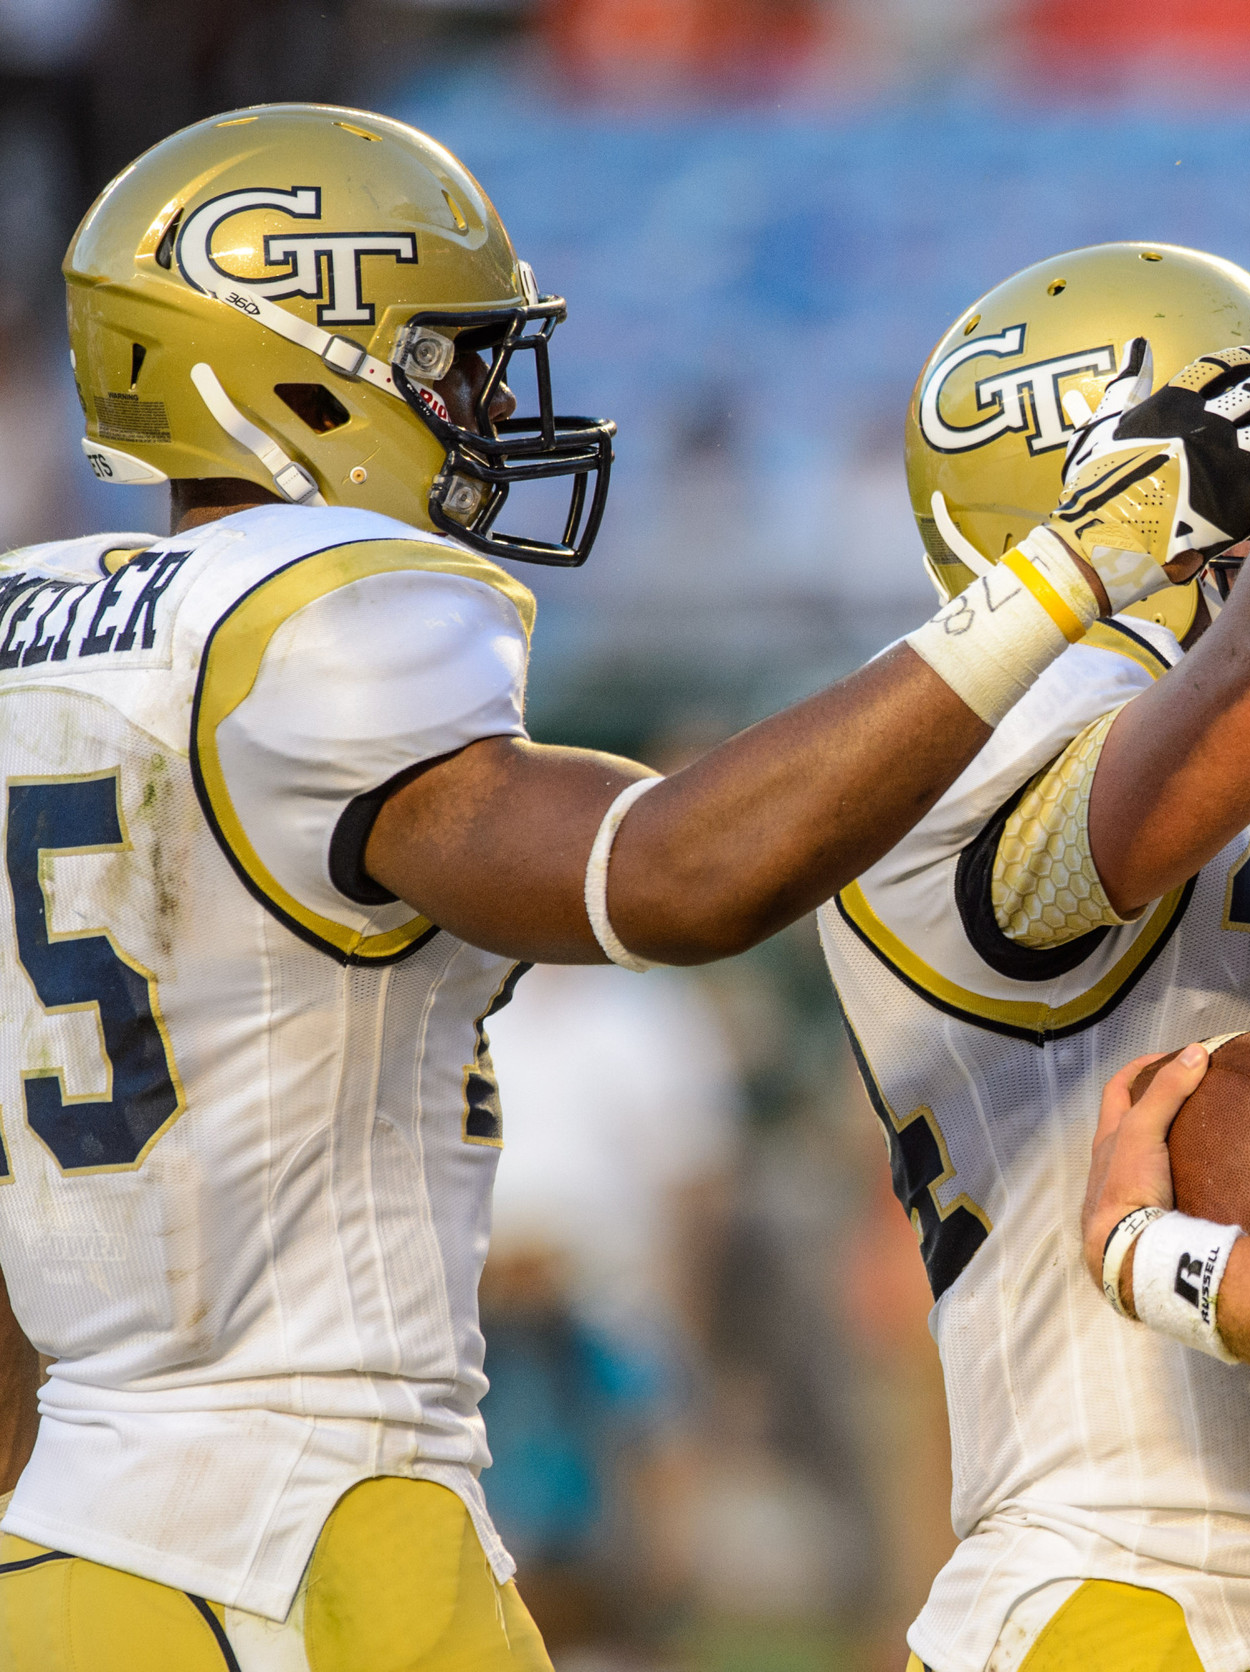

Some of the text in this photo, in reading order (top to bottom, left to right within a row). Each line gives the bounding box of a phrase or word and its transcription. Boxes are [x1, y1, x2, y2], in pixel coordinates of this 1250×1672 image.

[176, 186, 419, 326] GT
[108, 391, 139, 402] WARNING
[919, 322, 1117, 457] GT
[0, 767, 187, 1185] 5
[1200, 1246, 1221, 1326] RUSSELL
